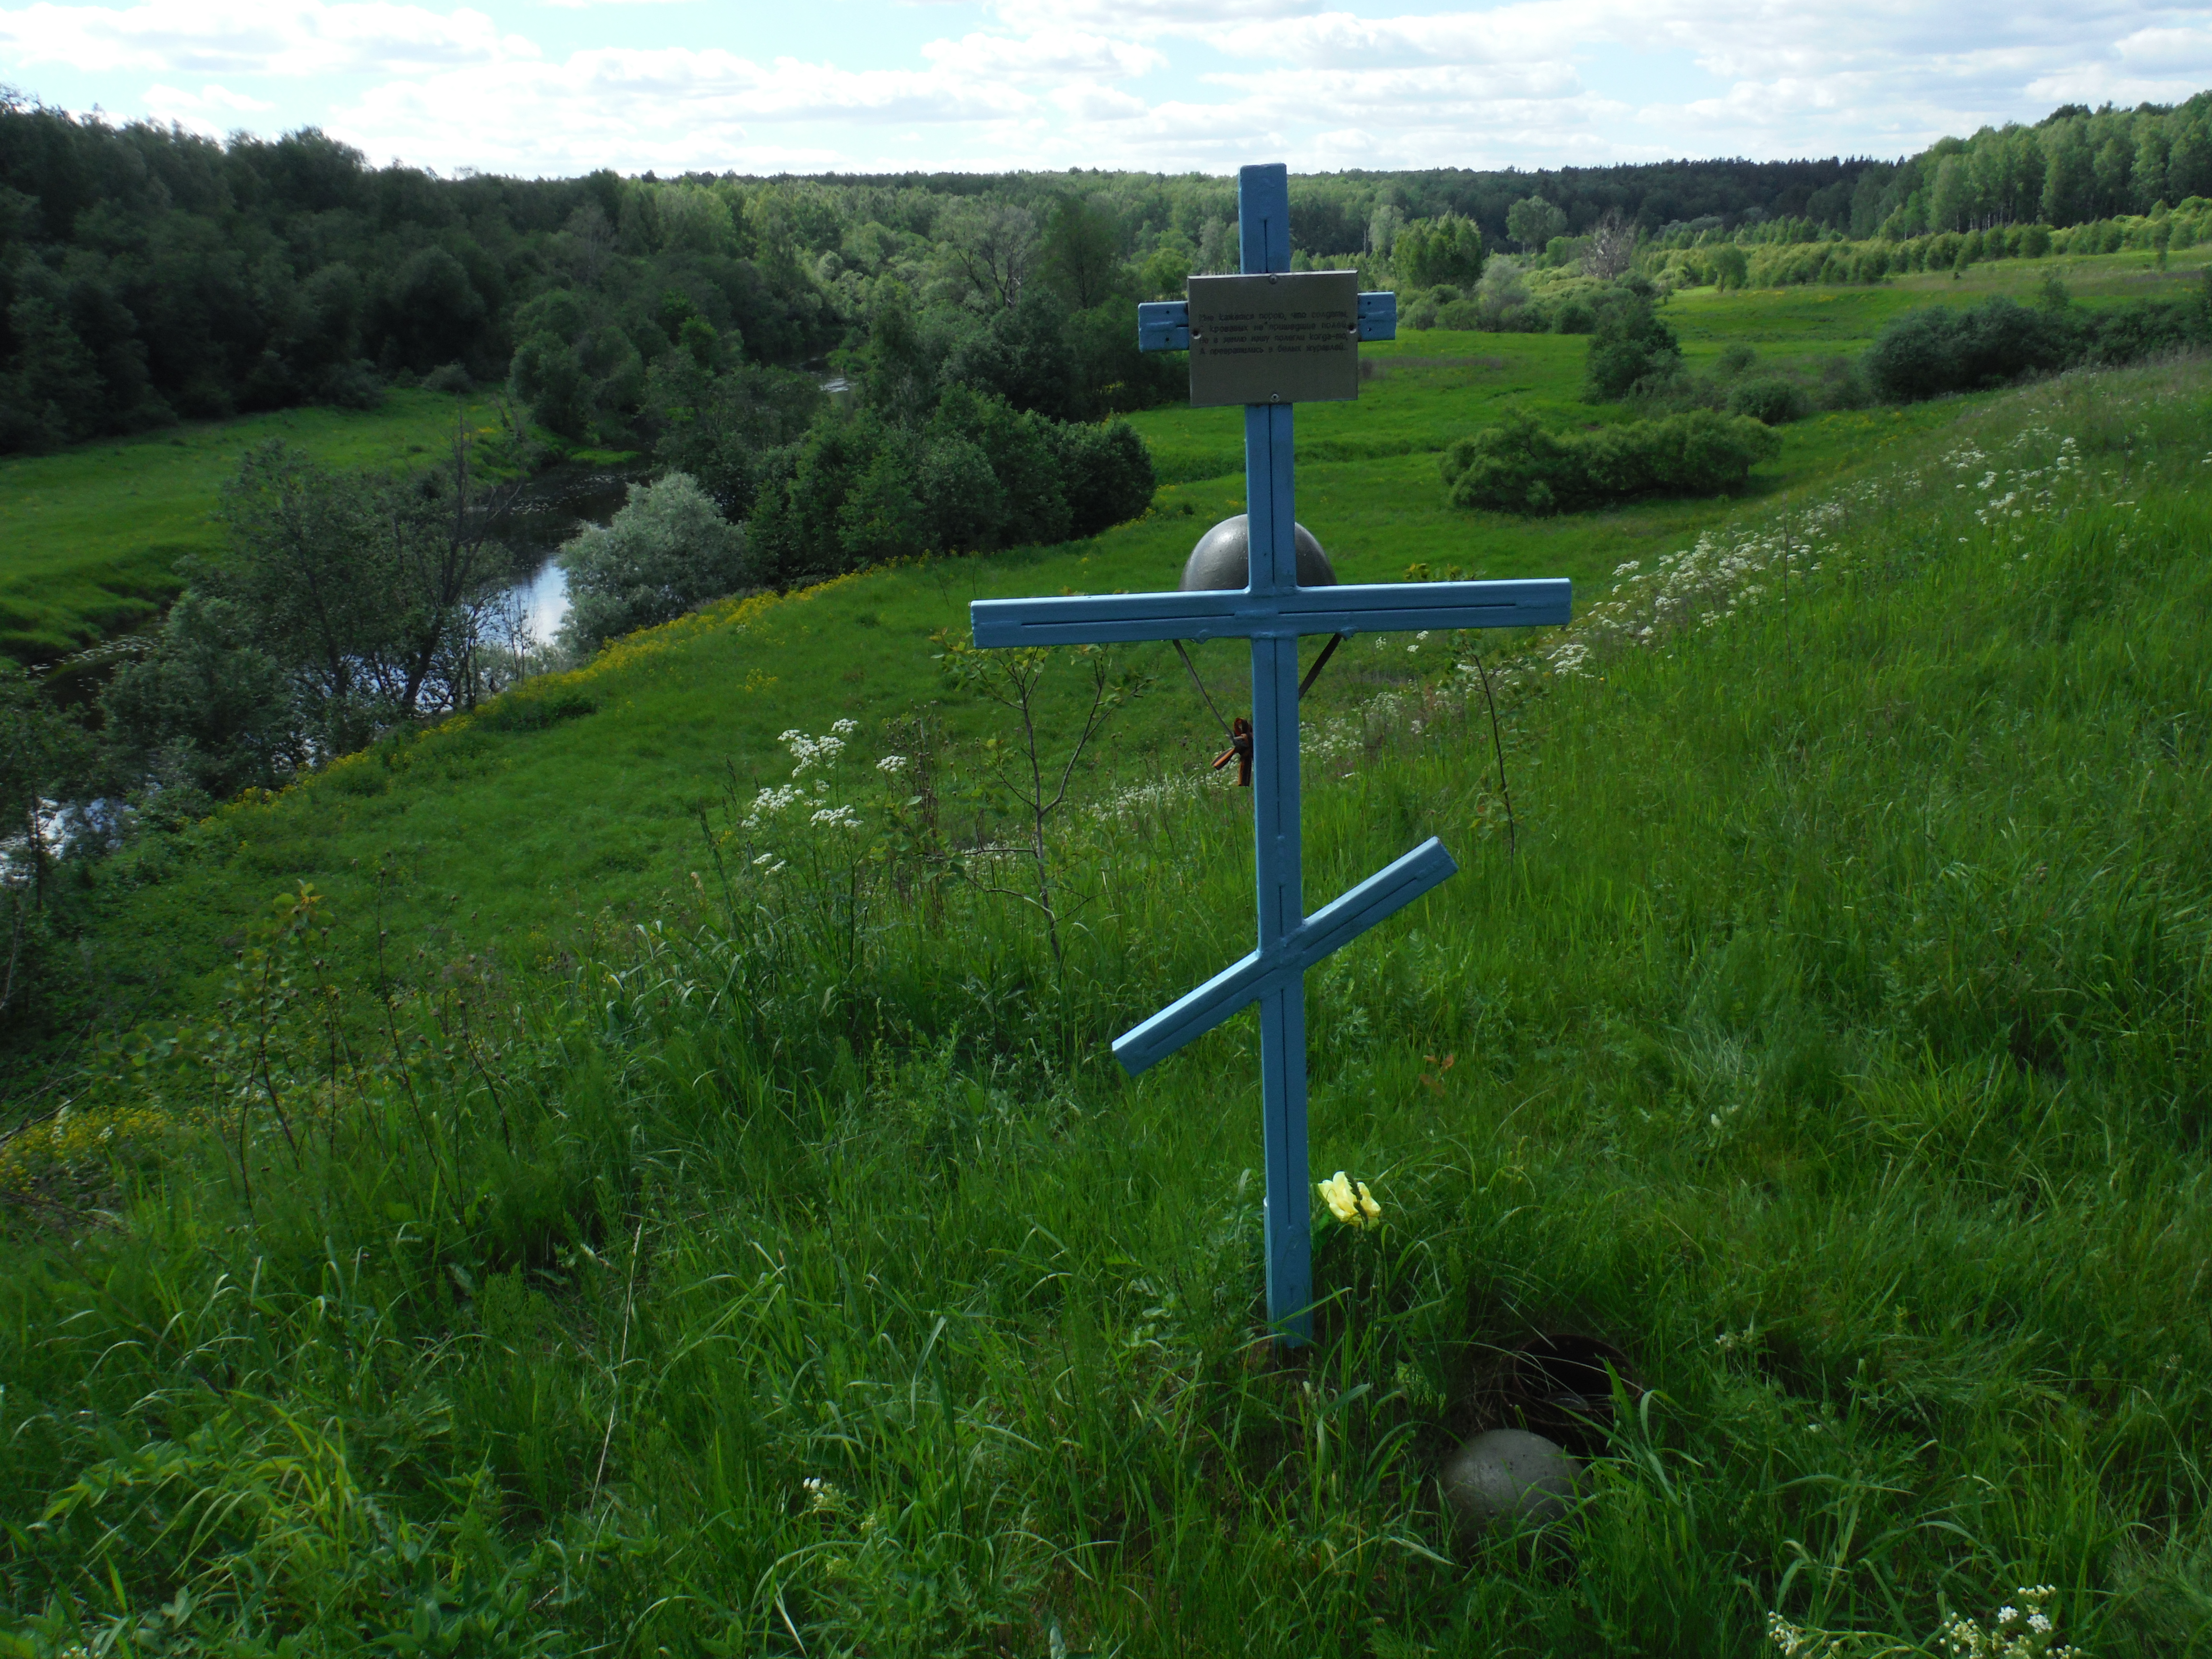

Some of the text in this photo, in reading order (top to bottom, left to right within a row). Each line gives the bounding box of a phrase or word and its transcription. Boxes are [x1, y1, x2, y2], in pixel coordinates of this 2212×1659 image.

[1199, 314, 1214, 322] Мне
[1259, 313, 1286, 321] порою,
[1209, 325, 1249, 333] кровавых
[1269, 323, 1316, 332] пришедшие
[1210, 347, 1264, 356] превратились
[1277, 344, 1301, 353] белых
